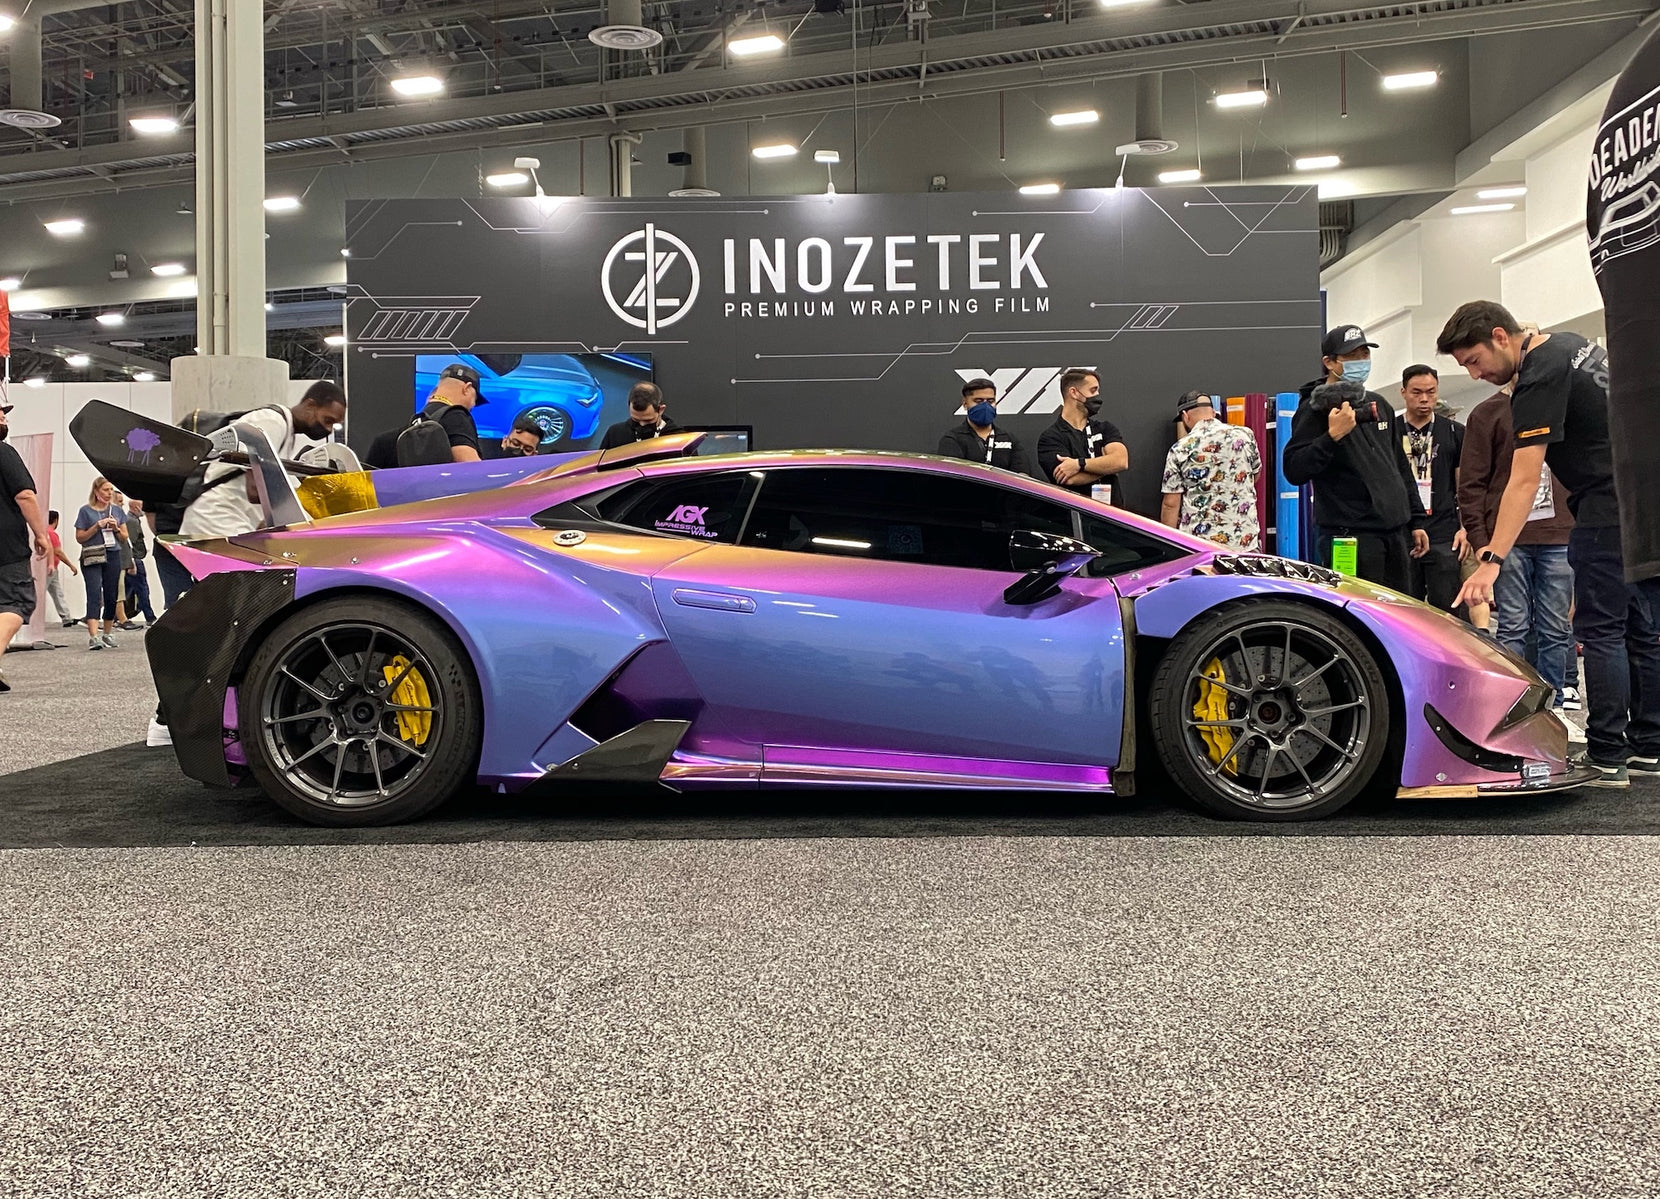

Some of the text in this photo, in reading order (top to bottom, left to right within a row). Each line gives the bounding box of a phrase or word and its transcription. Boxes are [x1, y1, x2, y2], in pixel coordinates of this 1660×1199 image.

[723, 232, 1049, 294] INOZETEK
[724, 296, 1050, 318] PREMIUM WRAPPING FILM
